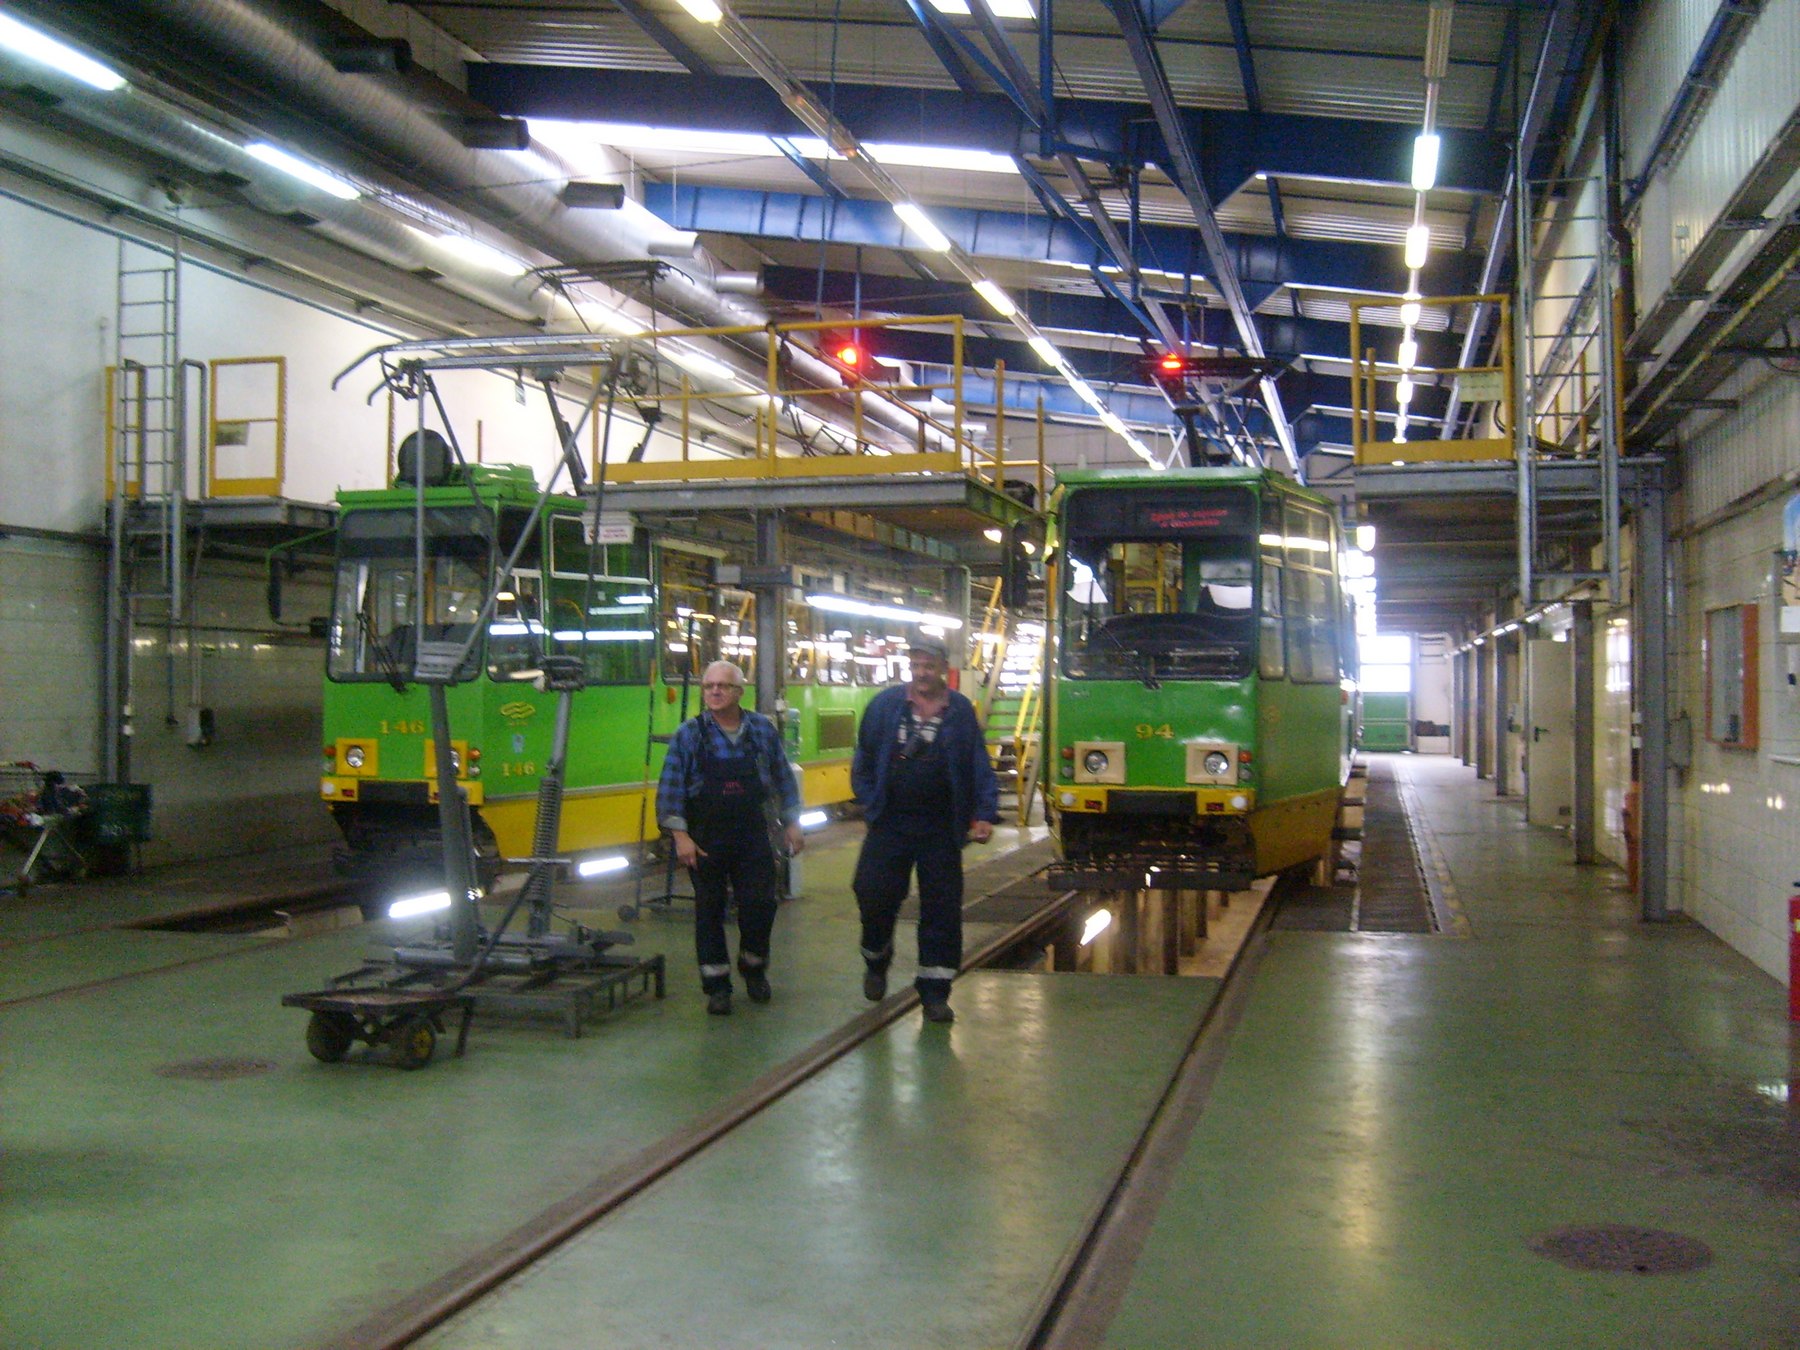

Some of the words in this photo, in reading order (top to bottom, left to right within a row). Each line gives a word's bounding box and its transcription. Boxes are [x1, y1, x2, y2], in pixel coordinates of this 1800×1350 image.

[379, 719, 425, 735] 146
[1136, 723, 1175, 739] 94
[502, 761, 535, 777] 146
